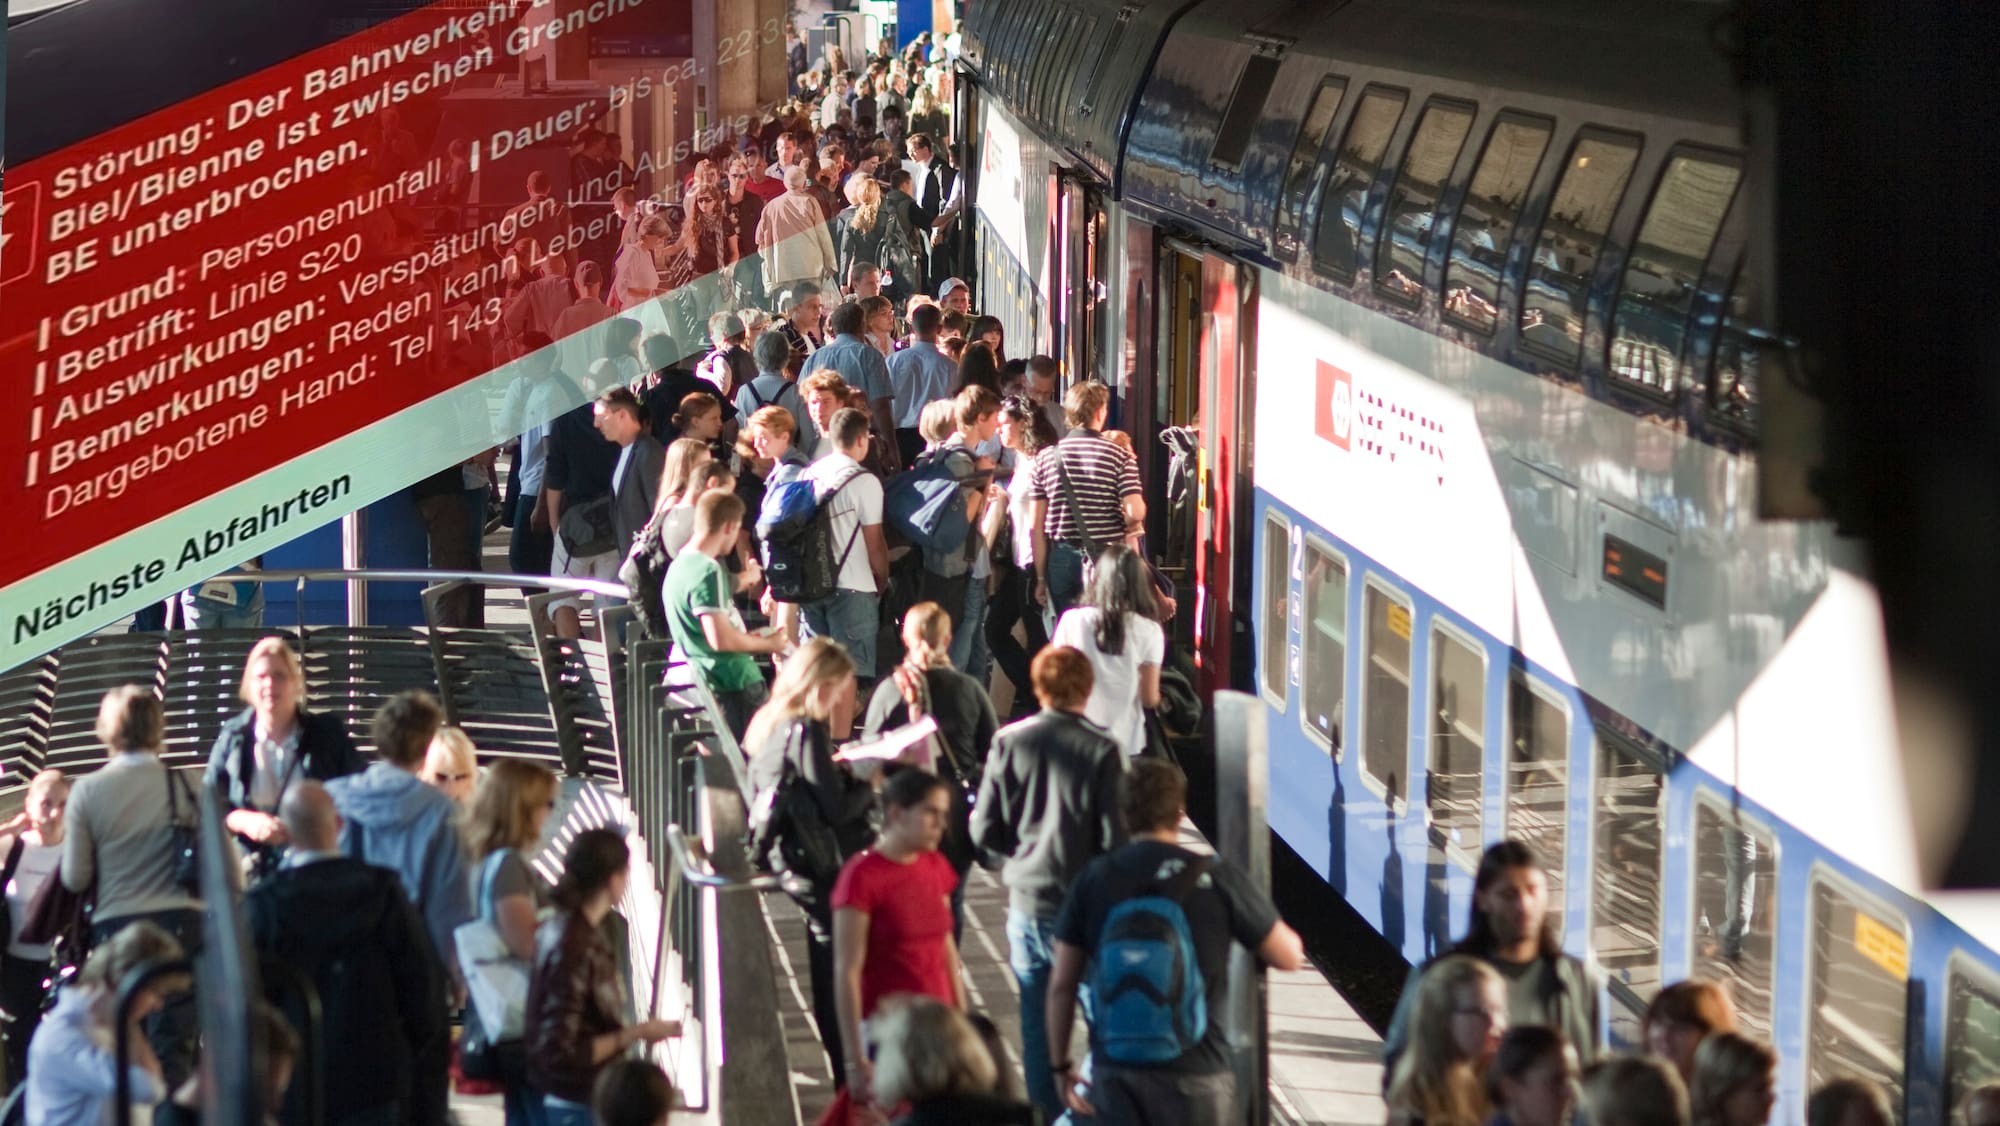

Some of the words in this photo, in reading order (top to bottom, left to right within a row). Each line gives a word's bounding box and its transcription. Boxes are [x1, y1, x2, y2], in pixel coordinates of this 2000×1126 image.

[46, 240, 98, 284] BE
[111, 140, 369, 257] unterbrochen.
[50, 138, 264, 242] Biel/Bienne
[277, 112, 321, 151] ist
[331, 46, 493, 129] zwischen
[52, 118, 214, 199] Störung:
[227, 87, 292, 130] Der
[60, 265, 187, 337] Grund:
[200, 157, 442, 281] Personenunfall
[491, 100, 596, 160] Dauer:
[608, 77, 652, 110] bis
[663, 57, 705, 87] ca.
[48, 342, 315, 474] Bemerkungen:
[327, 292, 431, 354] Reden
[444, 254, 517, 303] kann
[529, 213, 624, 266] Leben
[52, 295, 326, 428] Auswirkungen:
[339, 197, 555, 305] Verspätungen
[567, 162, 623, 207] und
[56, 308, 195, 384] Betrifft:
[209, 268, 287, 321] Linie
[299, 234, 363, 282] S20
[45, 404, 267, 519] Dargebotene
[280, 354, 376, 416] Hand:
[389, 325, 432, 365] Tel
[447, 297, 502, 340] 143
[13, 558, 165, 644] Nächste
[175, 474, 351, 571] Abfahrten
